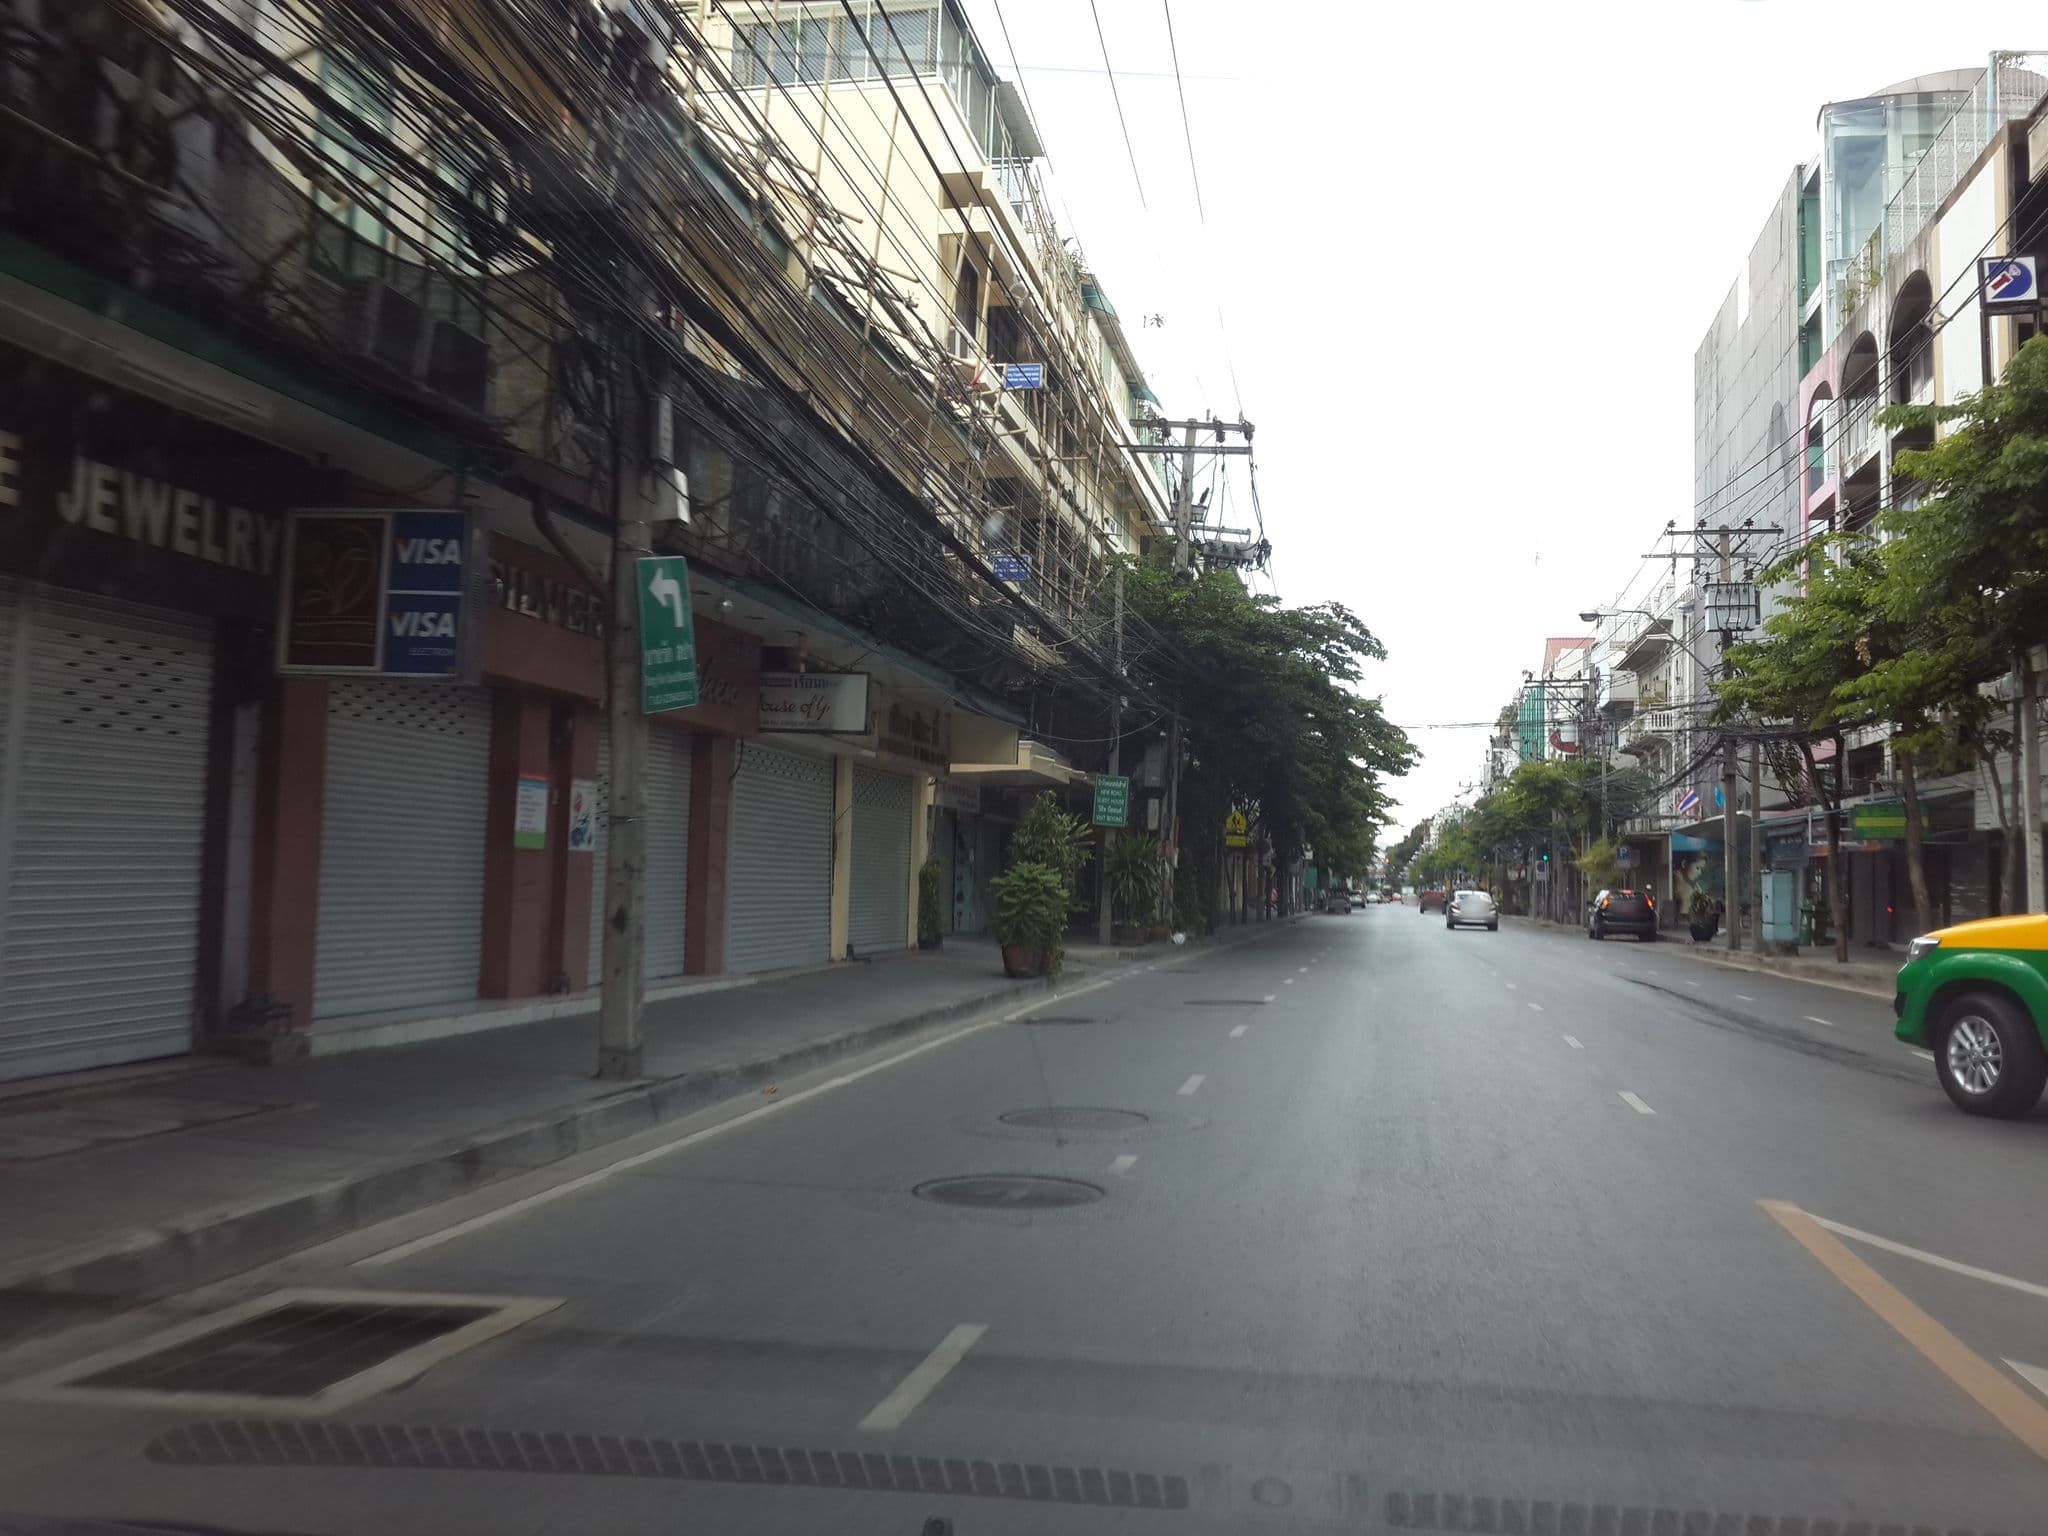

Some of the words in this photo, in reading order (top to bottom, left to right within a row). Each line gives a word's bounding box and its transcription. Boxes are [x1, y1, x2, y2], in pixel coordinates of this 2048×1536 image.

[58, 457, 278, 575] JEWELRY
[395, 538, 464, 565] VISA
[390, 611, 456, 637] VISA
